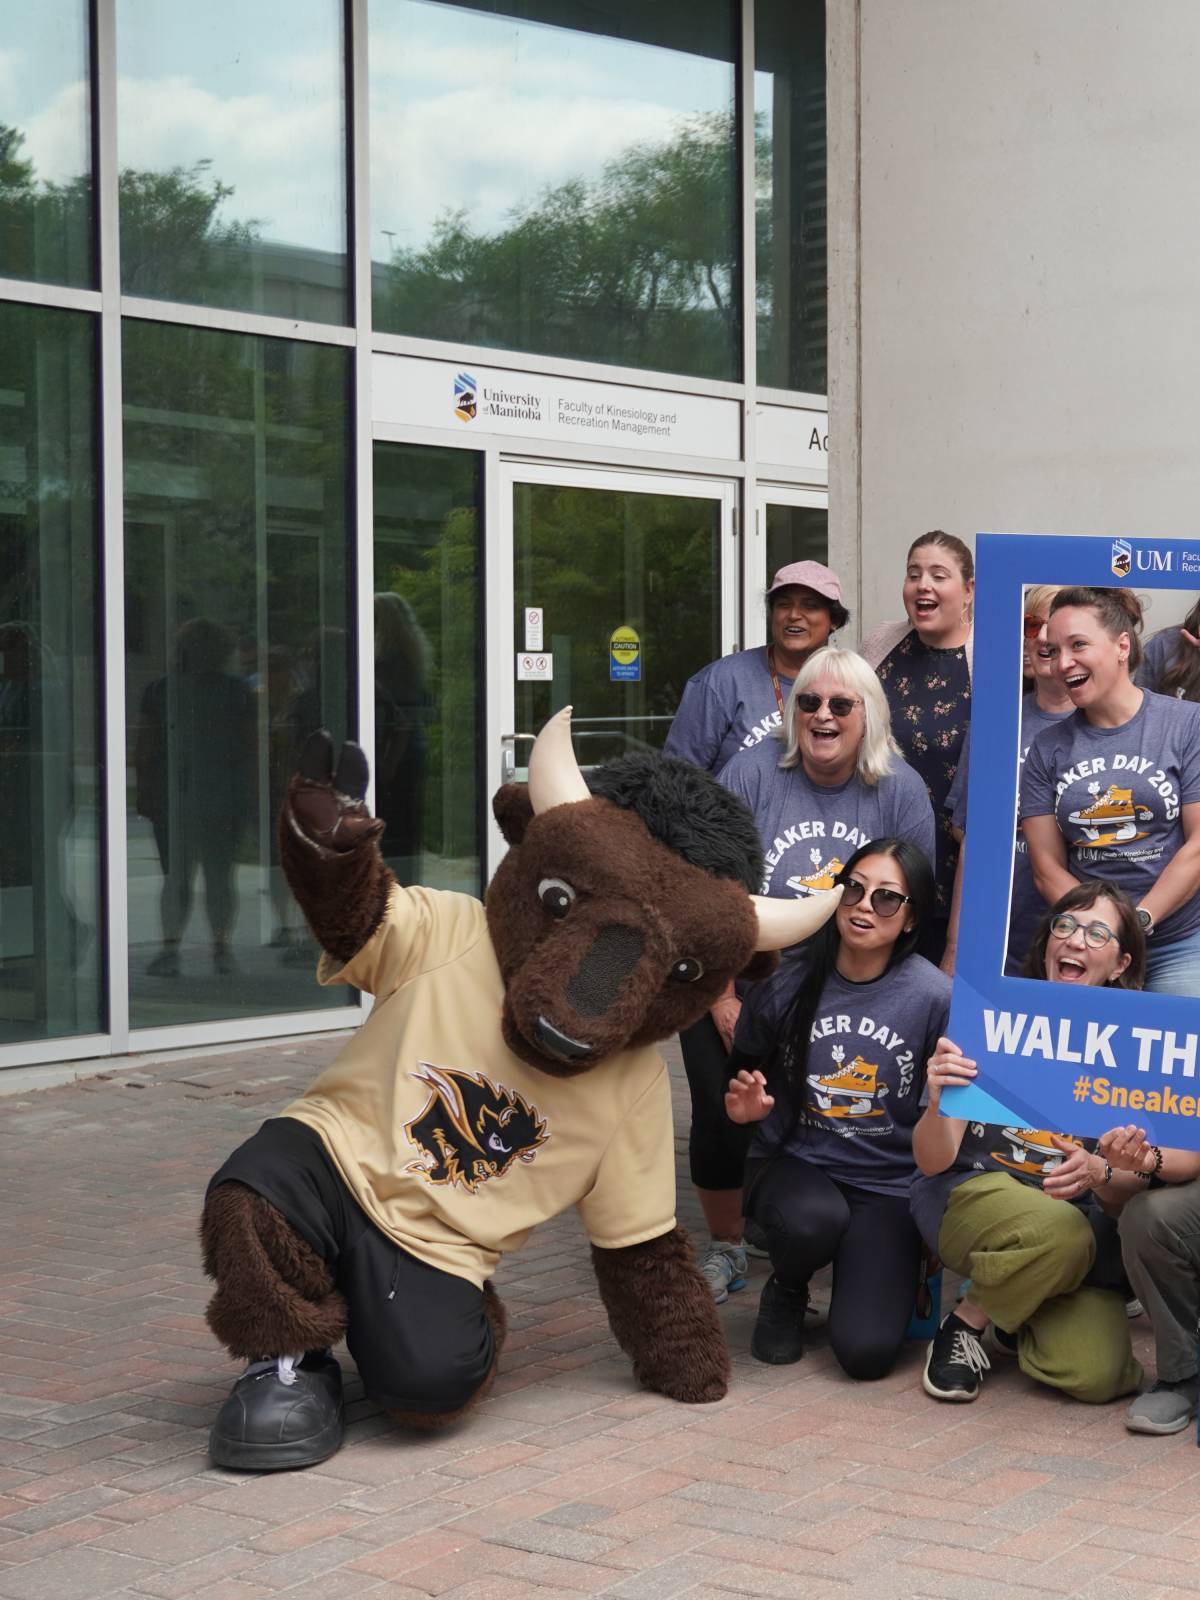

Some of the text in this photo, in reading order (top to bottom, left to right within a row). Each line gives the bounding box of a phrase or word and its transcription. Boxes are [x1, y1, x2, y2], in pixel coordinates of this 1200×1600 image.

[483, 388, 541, 409] University
[558, 398, 677, 424] Faculty of Kinesiology and
[490, 403, 541, 421] Manitoba
[558, 412, 671, 436] Recreation Management
[1136, 550, 1174, 571] UM
[1112, 754, 1154, 774] DAY
[1148, 770, 1179, 820] 2025
[832, 821, 872, 849] DAY
[983, 1009, 1119, 1068] WALK
[858, 1017, 904, 1050] DAY
[896, 1050, 915, 1098] 2025
